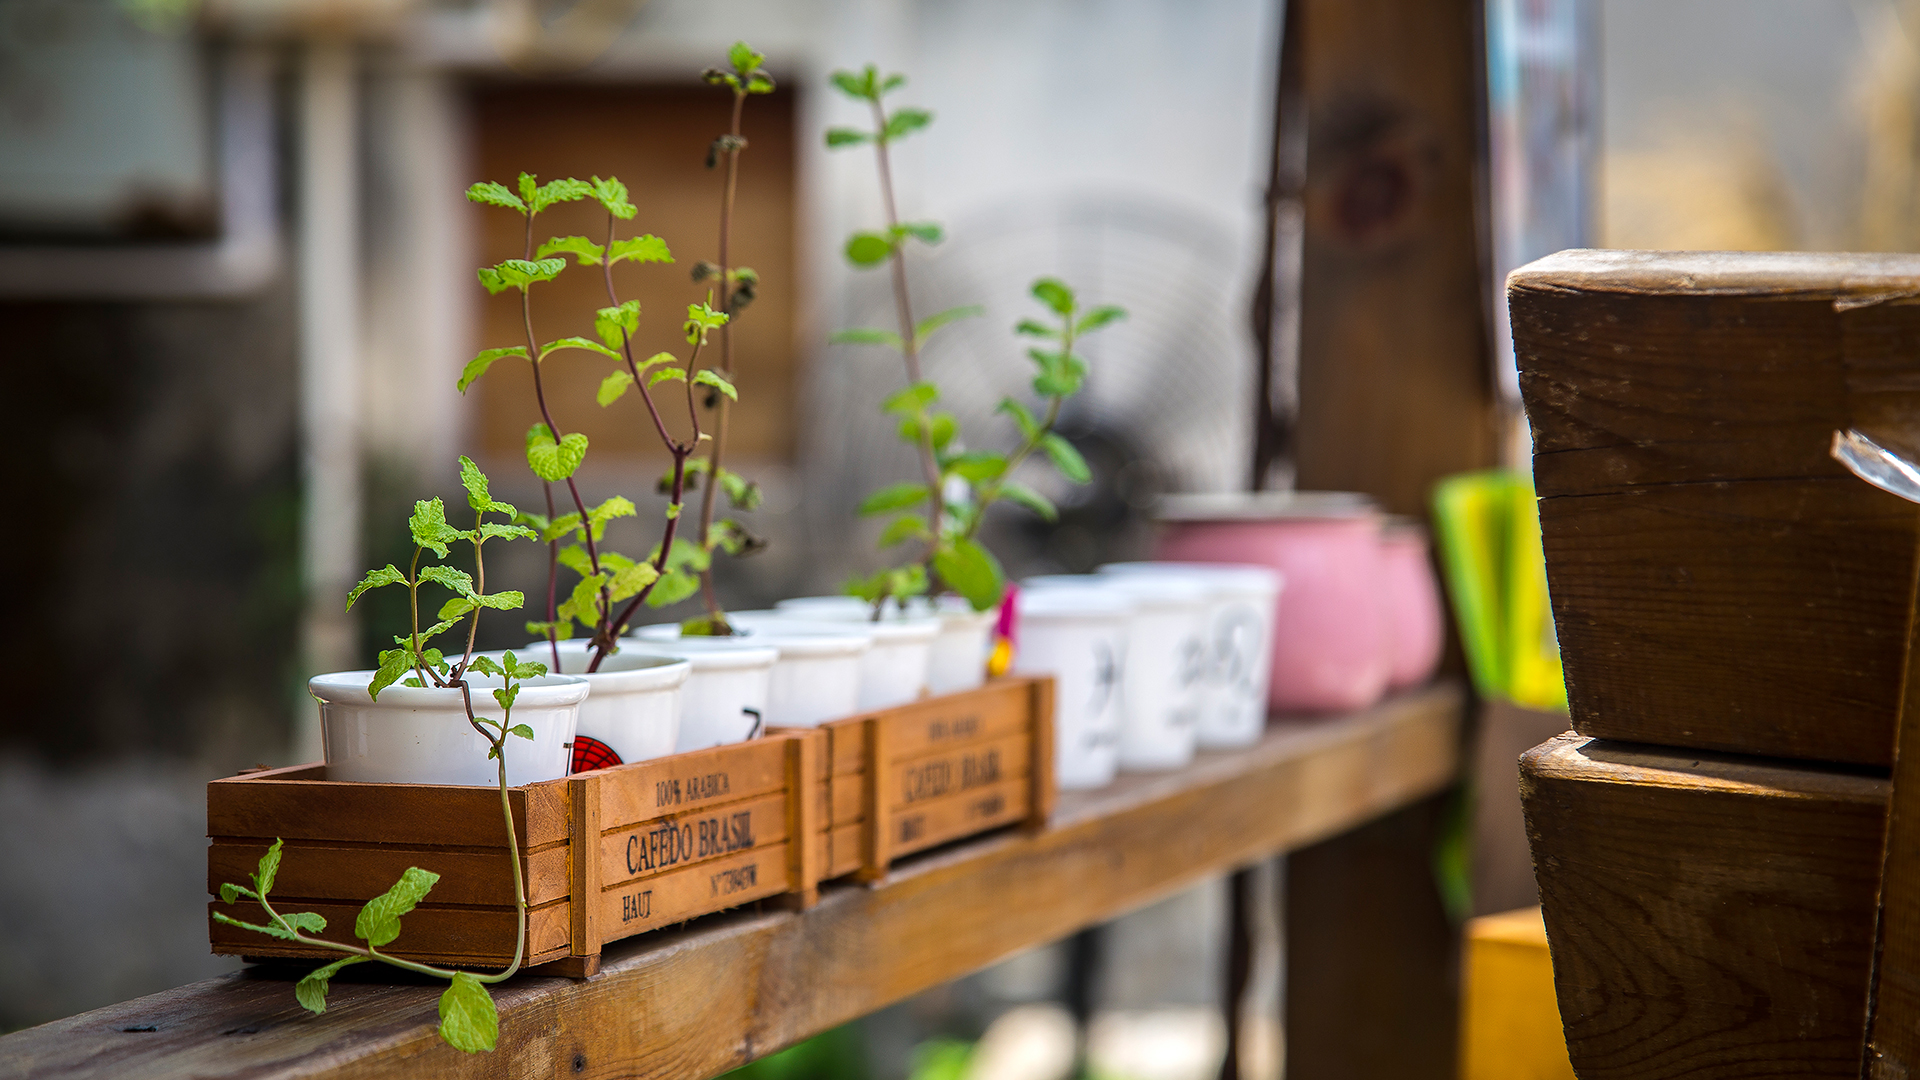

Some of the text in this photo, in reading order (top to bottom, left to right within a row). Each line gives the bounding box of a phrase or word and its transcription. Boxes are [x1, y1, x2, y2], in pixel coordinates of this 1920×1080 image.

[656, 772, 731, 807] 100% ARABICA
[698, 810, 755, 858] BRASIL
[622, 890, 652, 922] HAUT
